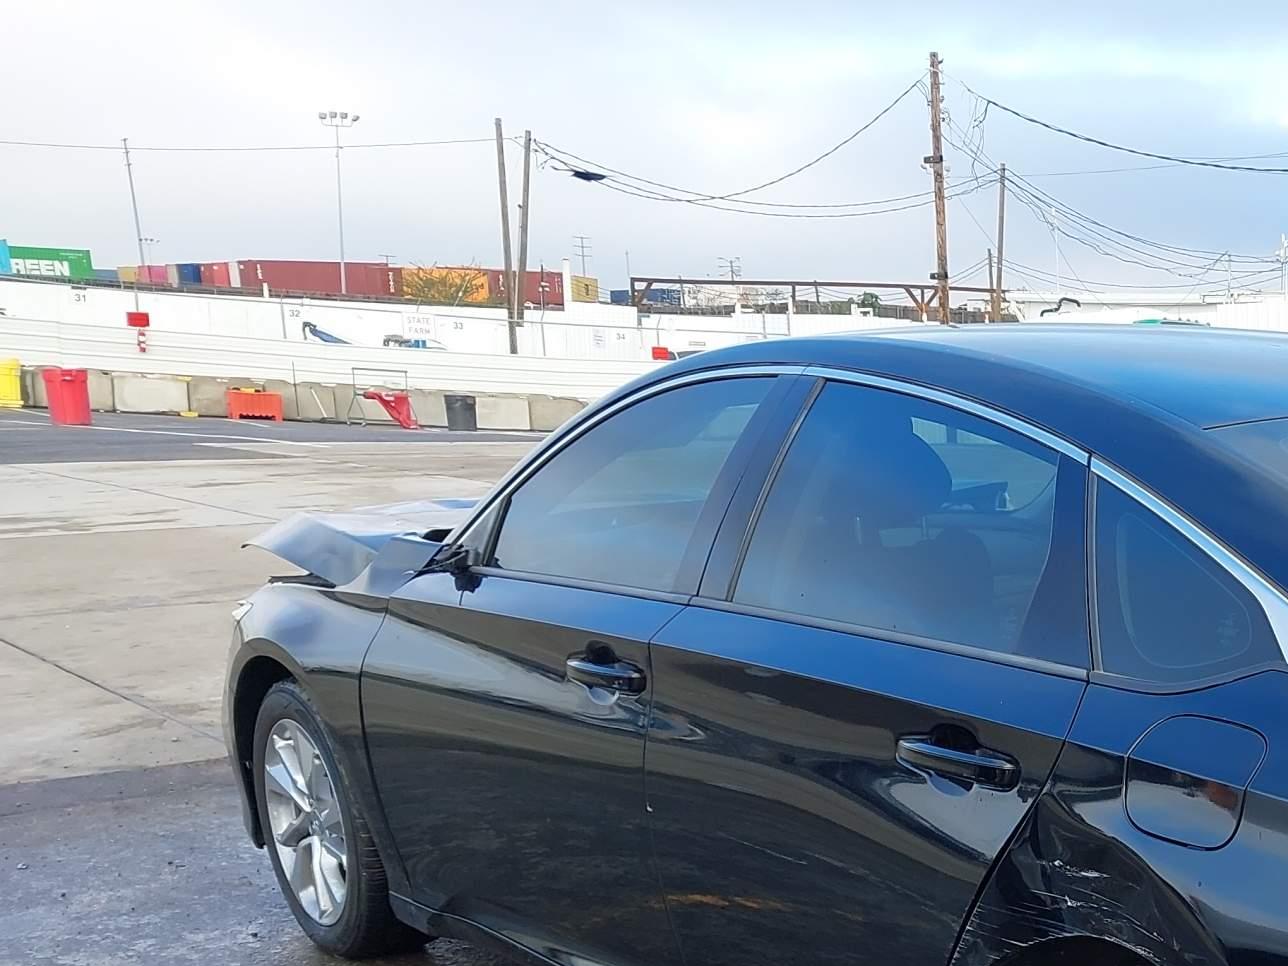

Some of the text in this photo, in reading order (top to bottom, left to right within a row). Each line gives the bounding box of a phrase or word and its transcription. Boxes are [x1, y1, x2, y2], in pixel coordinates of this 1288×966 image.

[75, 294, 86, 302] 31
[289, 309, 301, 317] 32
[407, 316, 431, 325] STATE
[454, 321, 464, 330] 33
[408, 326, 431, 334] FARM
